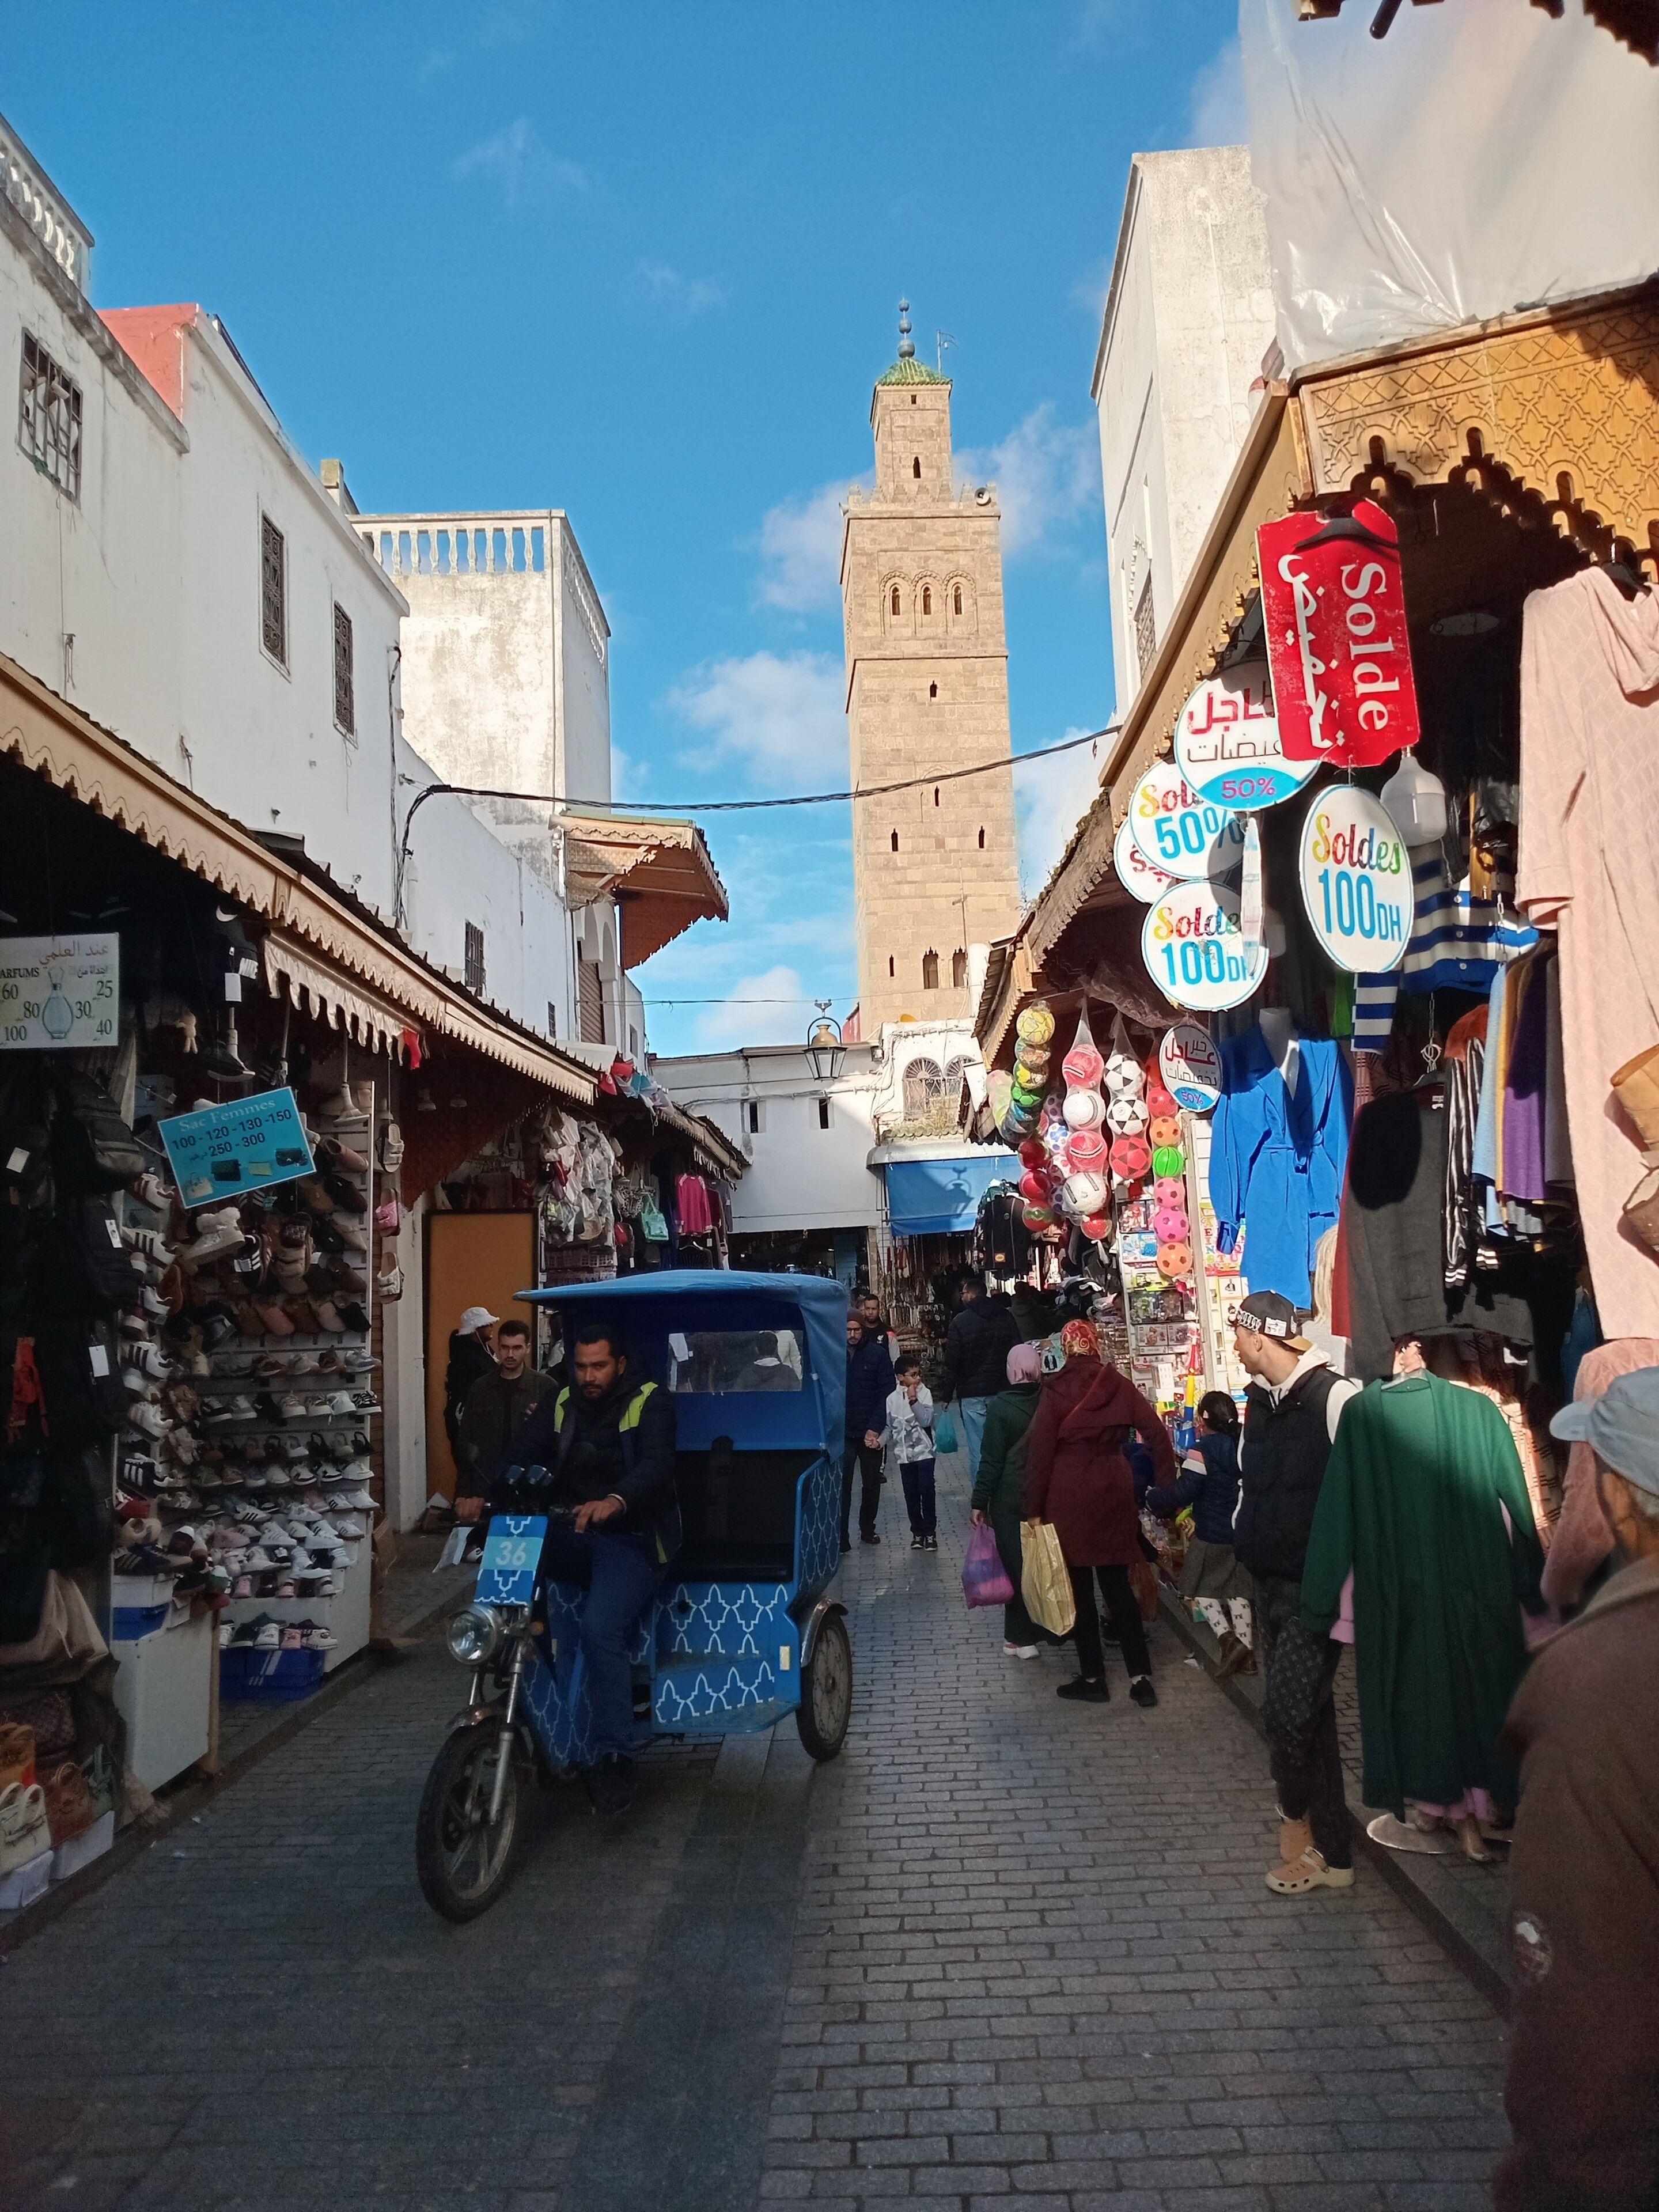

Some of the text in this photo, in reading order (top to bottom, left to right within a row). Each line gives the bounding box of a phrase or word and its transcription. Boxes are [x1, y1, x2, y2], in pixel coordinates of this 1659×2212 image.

[1278, 554, 1345, 749] تخفيض
[1340, 562, 1400, 730] Solde
[1188, 688, 1275, 734] اجل
[1221, 776, 1275, 800] 50%
[1154, 806, 1245, 859] 50%
[1312, 813, 1401, 874] Soldes
[1154, 906, 1242, 940] Solde
[2, 983, 18, 1000] 60
[97, 980, 113, 998] 25
[24, 1001, 40, 1019] 80
[75, 1001, 92, 1019] 30
[5, 1025, 27, 1041] 100
[96, 1018, 112, 1035] 40
[1181, 1089, 1204, 1105] 50%
[179, 1099, 275, 1132] Sac Femmes
[172, 1135, 196, 1150] 100
[206, 1126, 229, 1141] 120
[239, 1117, 262, 1132] 130
[209, 1142, 232, 1157] 250
[241, 1132, 266, 1147] 300
[495, 1541, 527, 1566] 36
